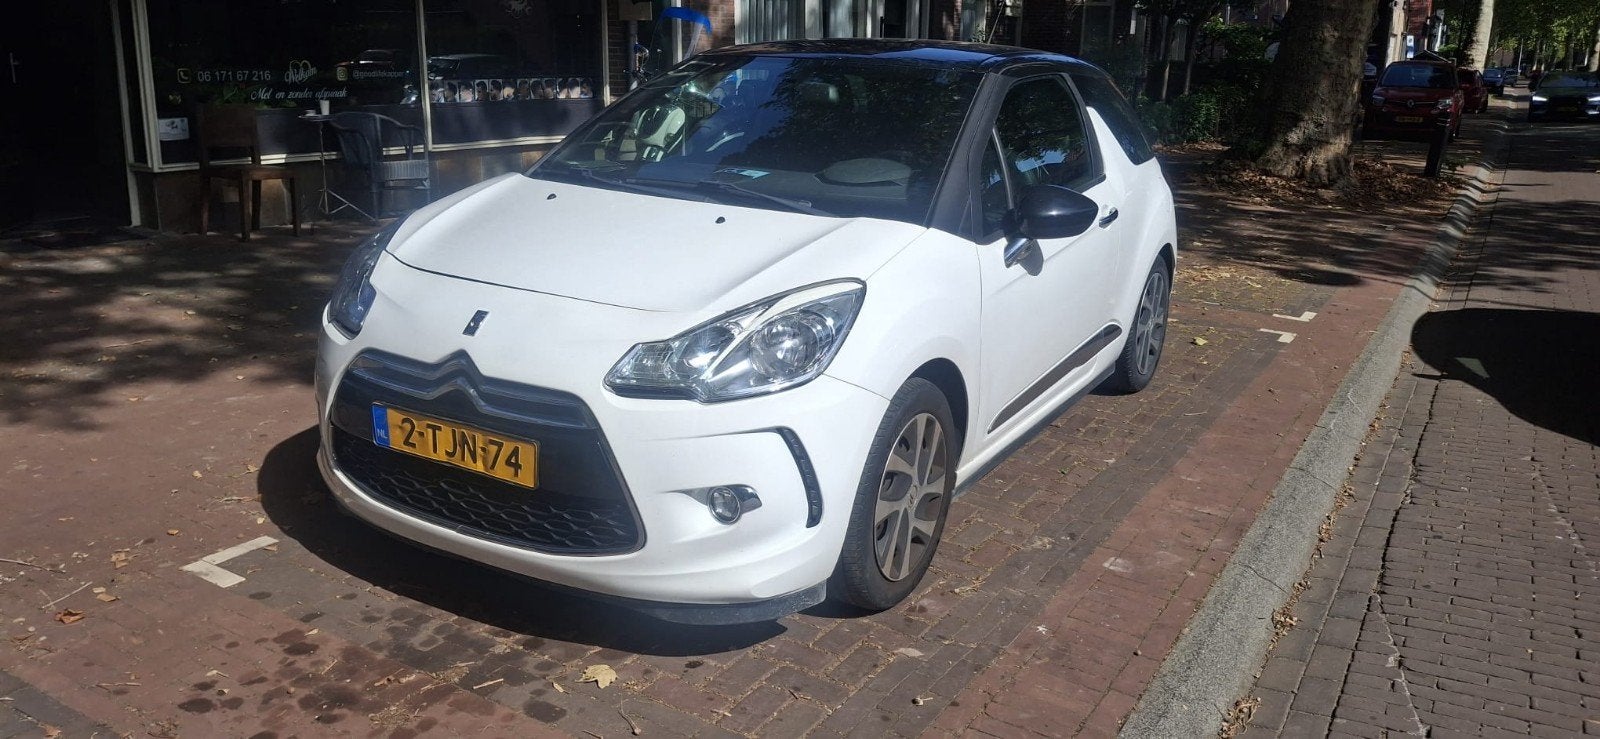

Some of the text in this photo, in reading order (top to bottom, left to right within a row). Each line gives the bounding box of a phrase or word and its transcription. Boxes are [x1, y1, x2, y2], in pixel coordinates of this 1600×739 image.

[198, 71, 271, 81] 06 171 67 216
[275, 91, 286, 99] en
[288, 88, 313, 99] zonder
[377, 428, 388, 439] NL
[401, 417, 523, 478] 2-TJN-74
